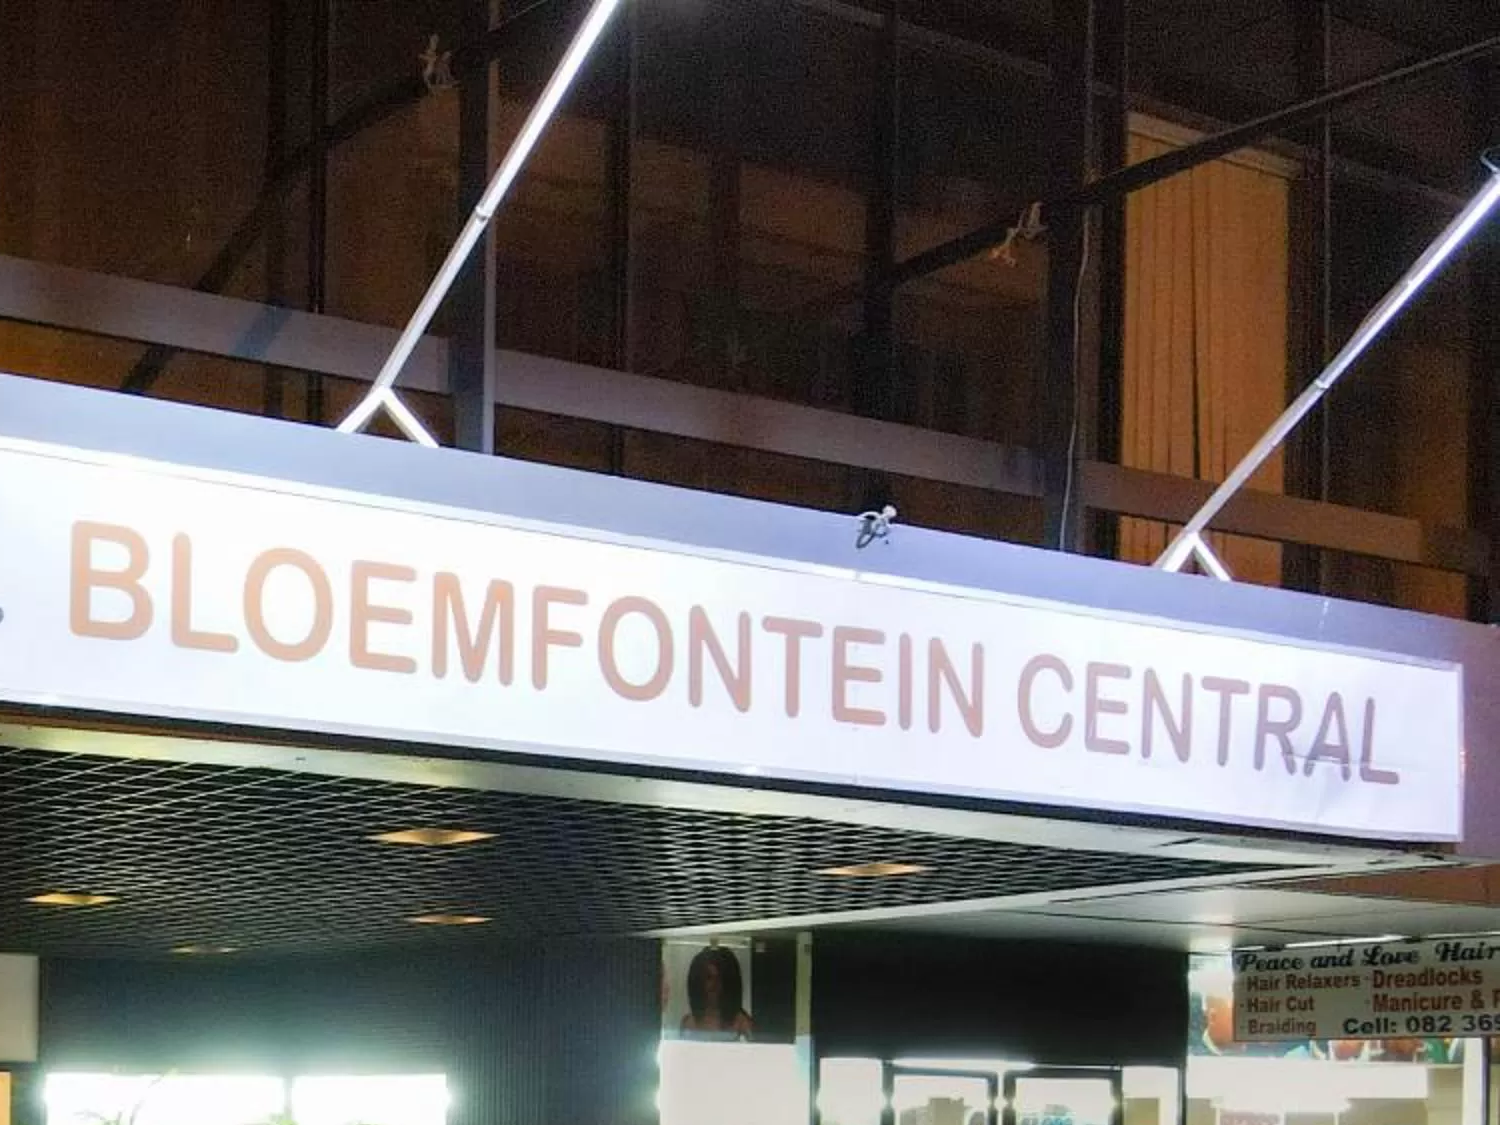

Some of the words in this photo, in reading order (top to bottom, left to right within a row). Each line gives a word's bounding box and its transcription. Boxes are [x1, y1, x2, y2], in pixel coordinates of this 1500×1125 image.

[68, 519, 985, 739] BLOEMFONTEIN
[1015, 653, 1401, 787] CENTRAL
[1236, 953, 1303, 972] Peace
[1310, 948, 1354, 969] and
[1246, 975, 1280, 992] Hair
[1372, 966, 1484, 989] Dreadlocks
[1246, 997, 1279, 1013] Hair
[1285, 995, 1315, 1012] Cut
[1372, 991, 1463, 1013] Manicure
[1342, 1016, 1397, 1035] Cell:
[1405, 1014, 1452, 1033] 082
